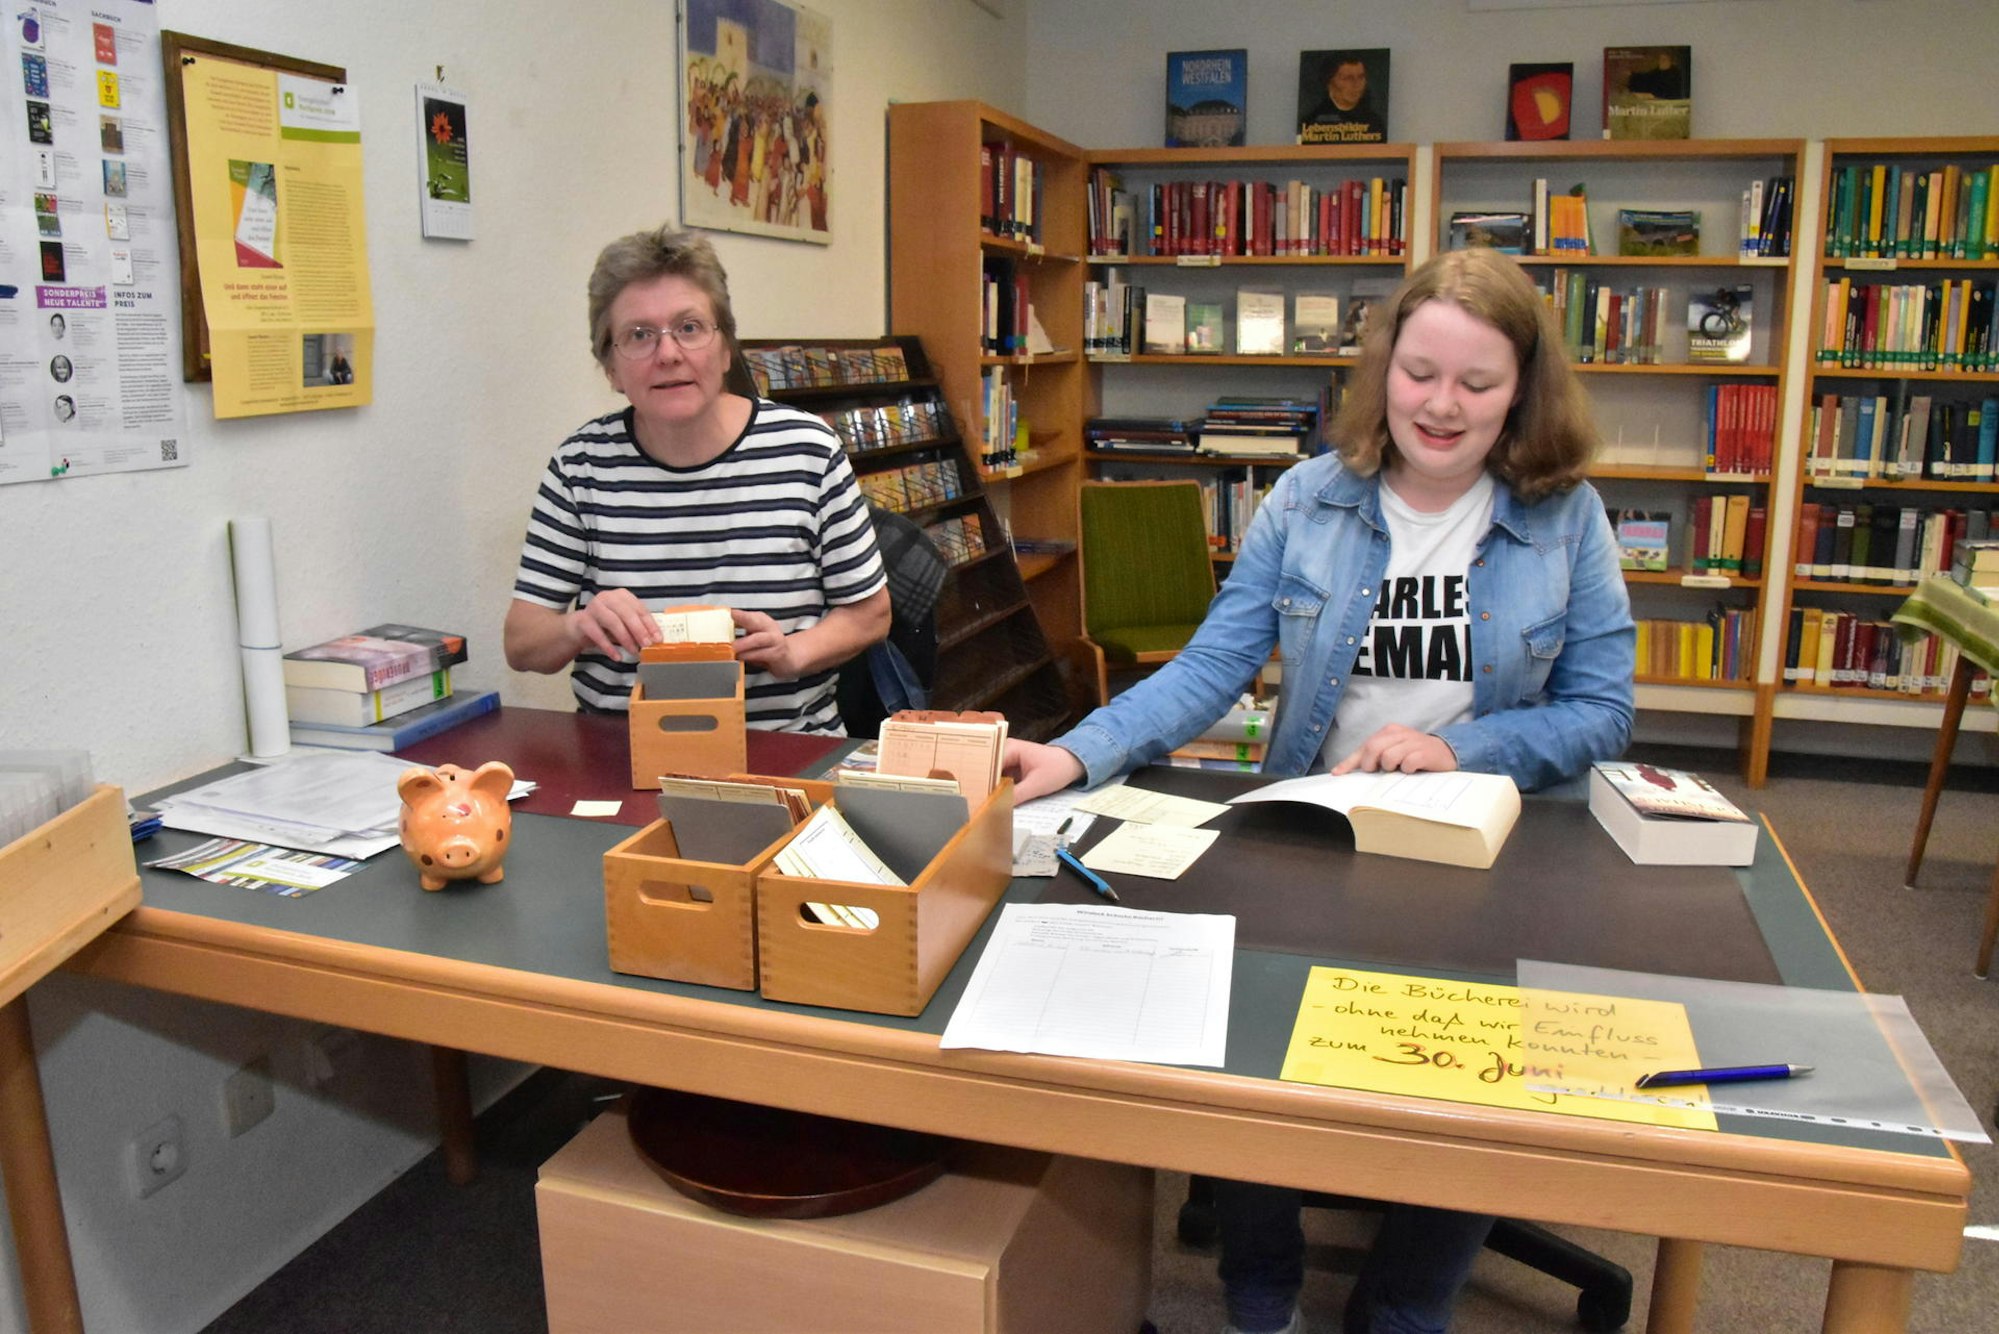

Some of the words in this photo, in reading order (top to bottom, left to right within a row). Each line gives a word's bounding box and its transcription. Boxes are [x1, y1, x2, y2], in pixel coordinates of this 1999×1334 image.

[1182, 59, 1231, 73] NORDRHEIN
[1182, 71, 1232, 85] WESTFALEN
[1608, 105, 1648, 116] Martin
[1650, 105, 1689, 116] Luther
[1302, 123, 1370, 133] Lebensbilder
[1302, 132, 1340, 141] Martin
[1341, 131, 1382, 141] Luthers
[43, 289, 97, 299] SONDERPREIS
[113, 291, 136, 299] INFOS
[137, 291, 152, 299] ZUM
[44, 298, 65, 307] NEUE
[114, 300, 136, 308] PREIS
[1332, 976, 1387, 993] Die
[1401, 983, 1530, 1009] Bücherei
[1545, 1002, 1616, 1017] wird
[1334, 1001, 1398, 1019] ohne
[1412, 1009, 1464, 1031] daß
[1480, 1018, 1520, 1031] wir
[1534, 1020, 1659, 1046] Einfluss
[1381, 1025, 1490, 1046] nehmen
[1308, 1036, 1367, 1052] zum
[1372, 1042, 1465, 1068] 30.
[1478, 1051, 1565, 1084] Juni
